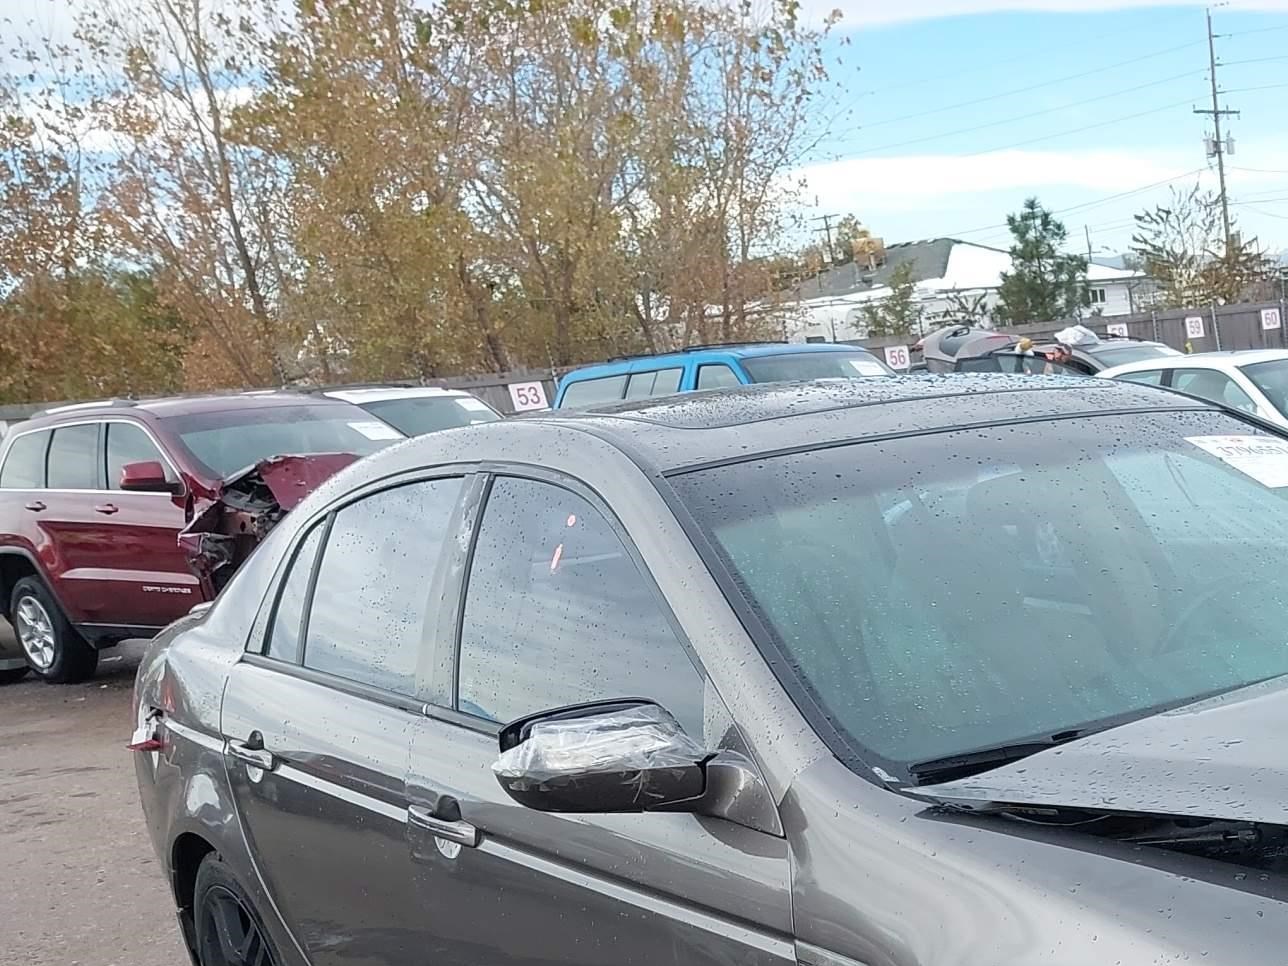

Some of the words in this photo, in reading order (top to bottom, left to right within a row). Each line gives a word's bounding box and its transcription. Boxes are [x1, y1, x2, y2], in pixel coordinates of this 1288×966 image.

[1189, 319, 1201, 335] 59
[1265, 311, 1278, 326] 60
[889, 348, 906, 366] 56
[516, 386, 541, 406] 53
